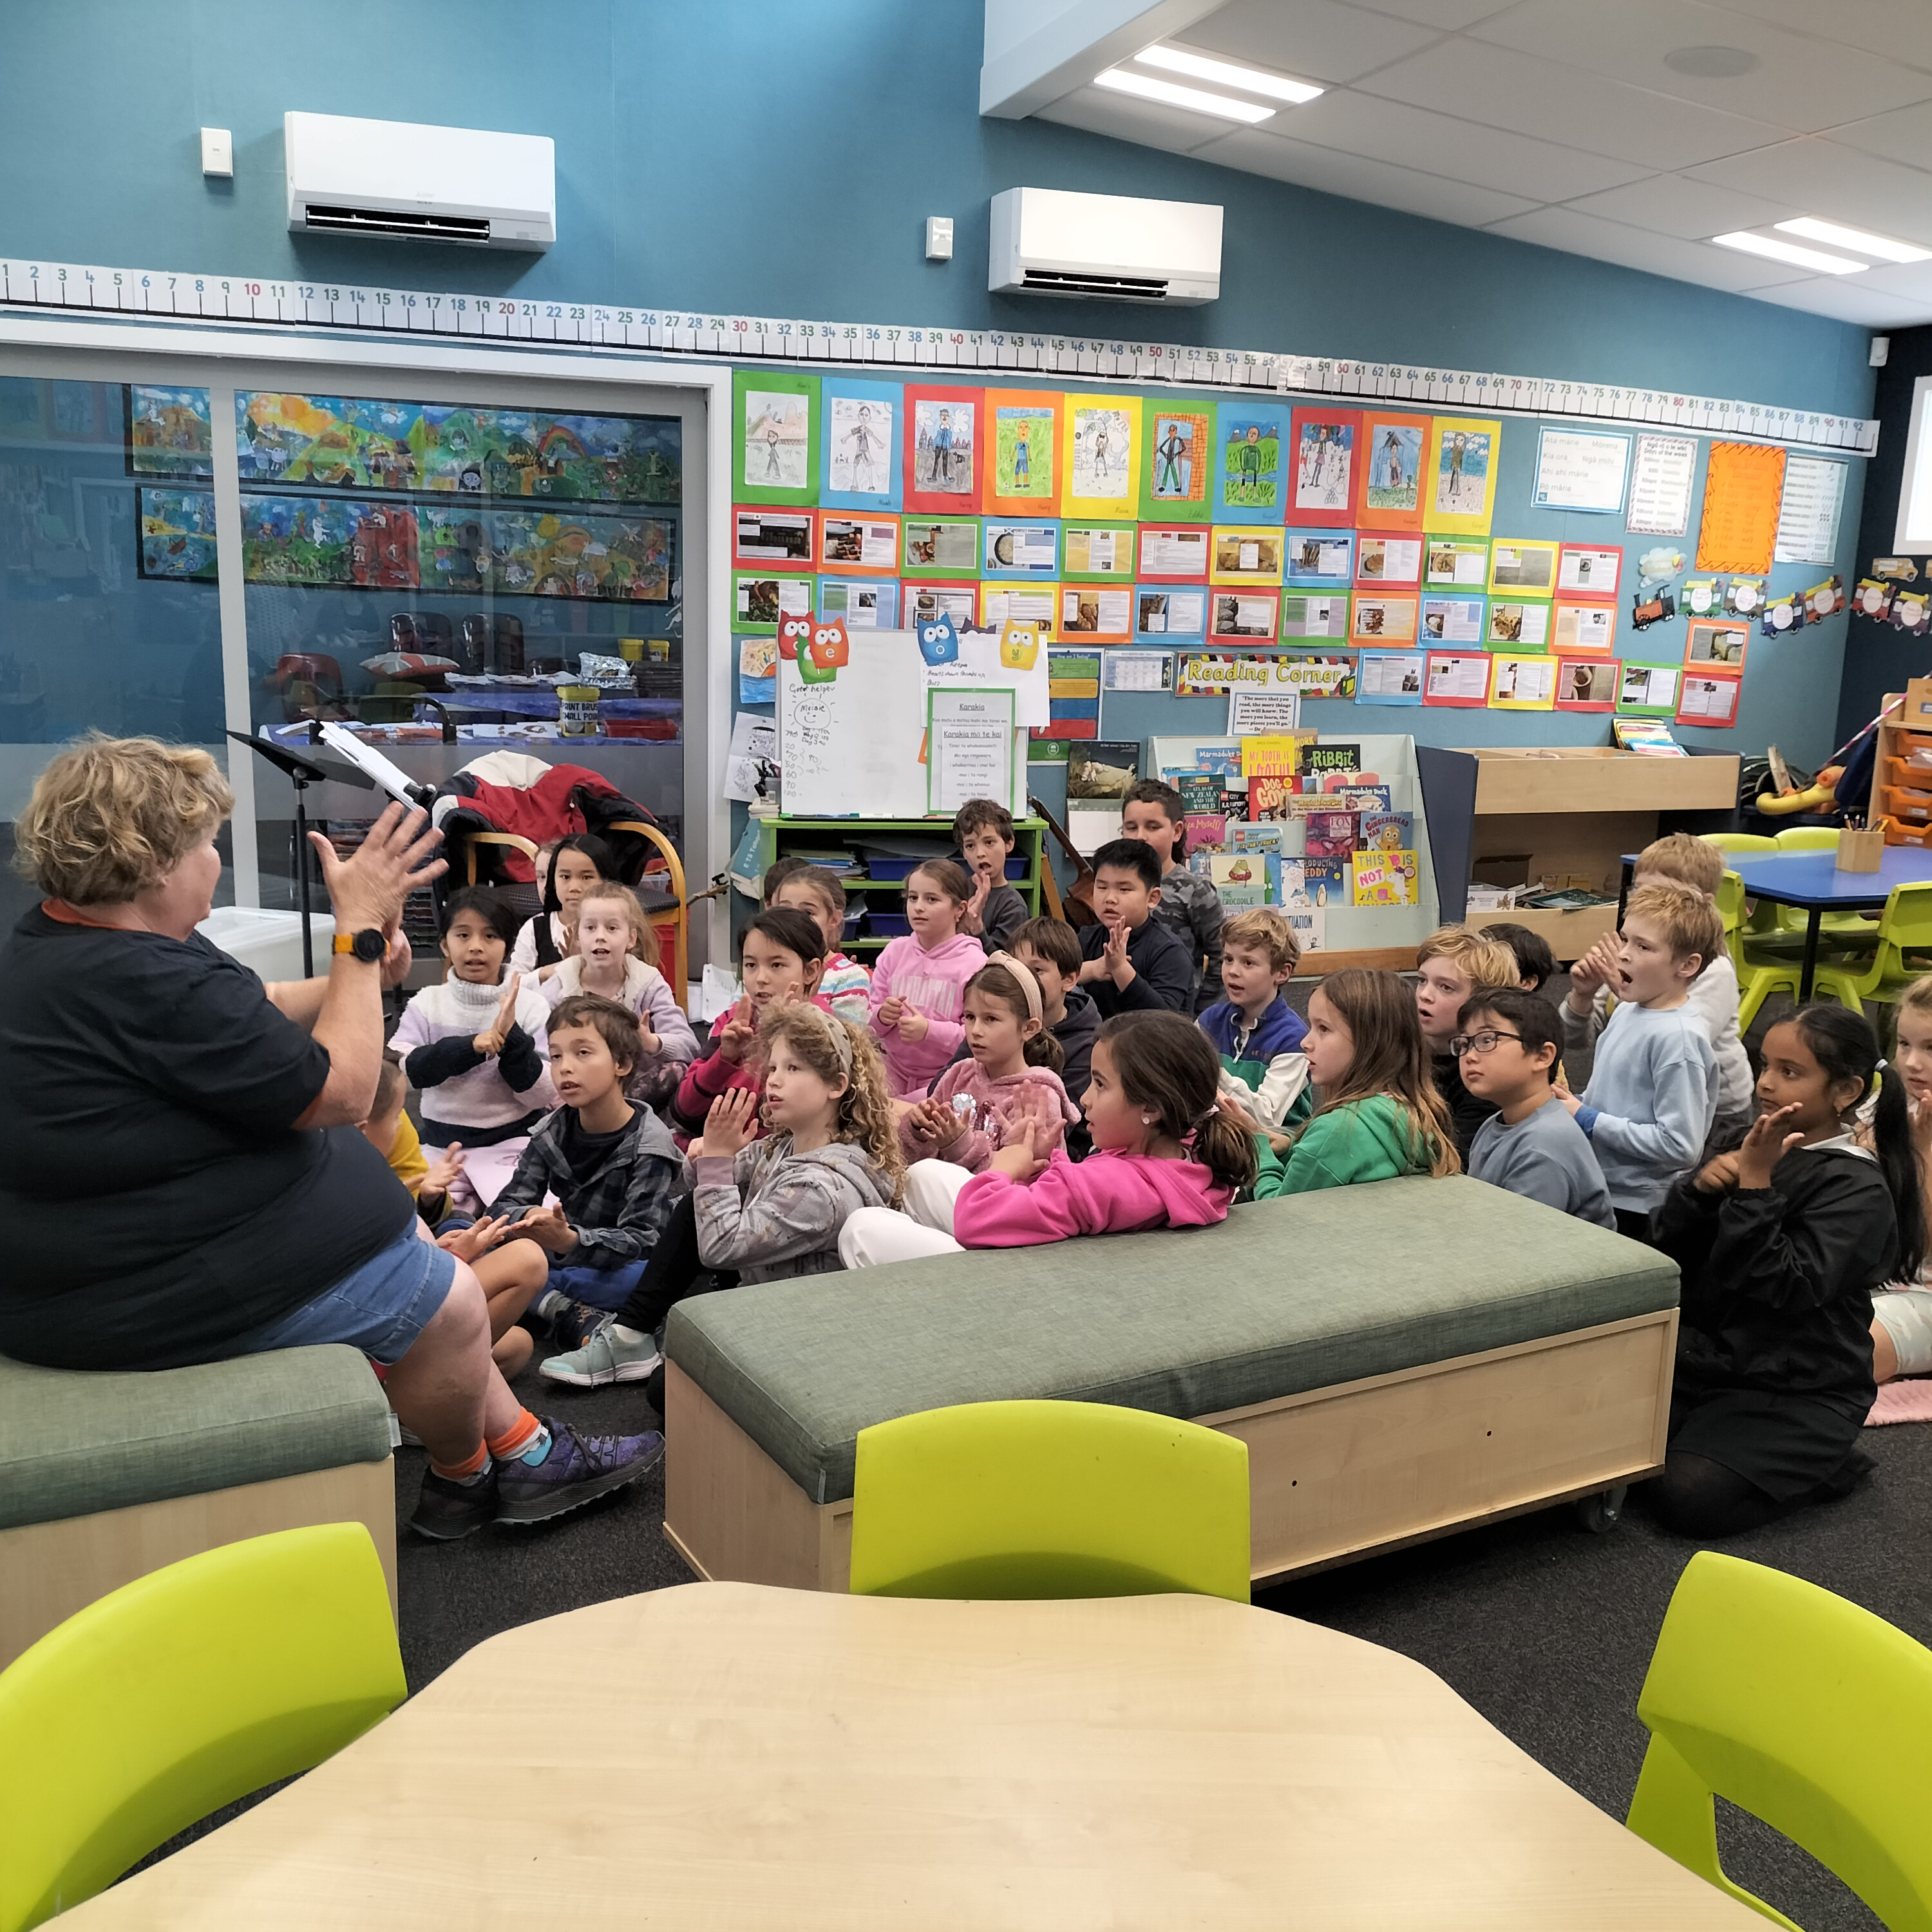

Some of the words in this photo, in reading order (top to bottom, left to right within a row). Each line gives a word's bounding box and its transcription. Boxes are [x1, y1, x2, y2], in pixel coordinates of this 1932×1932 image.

[3, 263, 8, 276] 1
[30, 265, 39, 279] 2
[58, 268, 67, 281] 3
[86, 270, 95, 283] 4
[113, 272, 122, 286] 5
[142, 275, 150, 288] 6
[168, 277, 176, 290] 7
[196, 279, 204, 292] 8
[222, 281, 230, 294] 9
[245, 283, 261, 296] 10
[270, 285, 285, 298] 11
[298, 286, 314, 299] 12
[324, 288, 339, 301] 13
[350, 290, 365, 303] 14
[375, 292, 391, 305] 15
[401, 294, 416, 307] 16
[426, 296, 440, 309] 17
[451, 298, 466, 311] 18
[475, 299, 490, 313] 19
[498, 302, 515, 315] 20
[523, 304, 536, 316] 21
[546, 305, 562, 318] 22
[570, 307, 585, 320] 23
[594, 310, 610, 321] 24
[618, 311, 633, 324] 25
[641, 313, 656, 326] 26
[665, 316, 680, 327] 27
[687, 316, 703, 329] 28
[710, 318, 725, 330] 29
[732, 320, 748, 332] 30
[755, 321, 768, 334] 31
[777, 323, 791, 336] 32
[800, 325, 814, 336] 33
[822, 326, 836, 338] 34
[843, 327, 857, 339] 35
[866, 328, 880, 339] 36
[887, 329, 901, 341] 37
[908, 331, 922, 342] 38
[929, 332, 942, 343] 39
[950, 334, 963, 345] 40
[1493, 378, 1505, 388] 69
[1510, 379, 1522, 390] 70
[1594, 387, 1604, 397] 75
[1673, 397, 1684, 406] 80
[1750, 406, 1760, 417] 85
[1824, 417, 1834, 427] 90
[1853, 421, 1863, 431] 92
[826, 648, 835, 658] e
[1188, 661, 1269, 687] Reading
[1276, 662, 1341, 683] Corner
[1249, 751, 1258, 761] MY
[1261, 750, 1281, 762] TOOTH
[1284, 751, 1289, 759] IS
[786, 770, 797, 779] 60
[1262, 778, 1282, 790] DOG
[1331, 817, 1350, 826] FOX
[1365, 816, 1409, 831] GINGERBREAD
[1367, 828, 1381, 839] MAN
[1358, 855, 1385, 867] THIS
[1403, 854, 1413, 865] IS
[1305, 867, 1327, 877] EDDY
[1359, 869, 1383, 886] NOT
[1367, 891, 1374, 900] A
